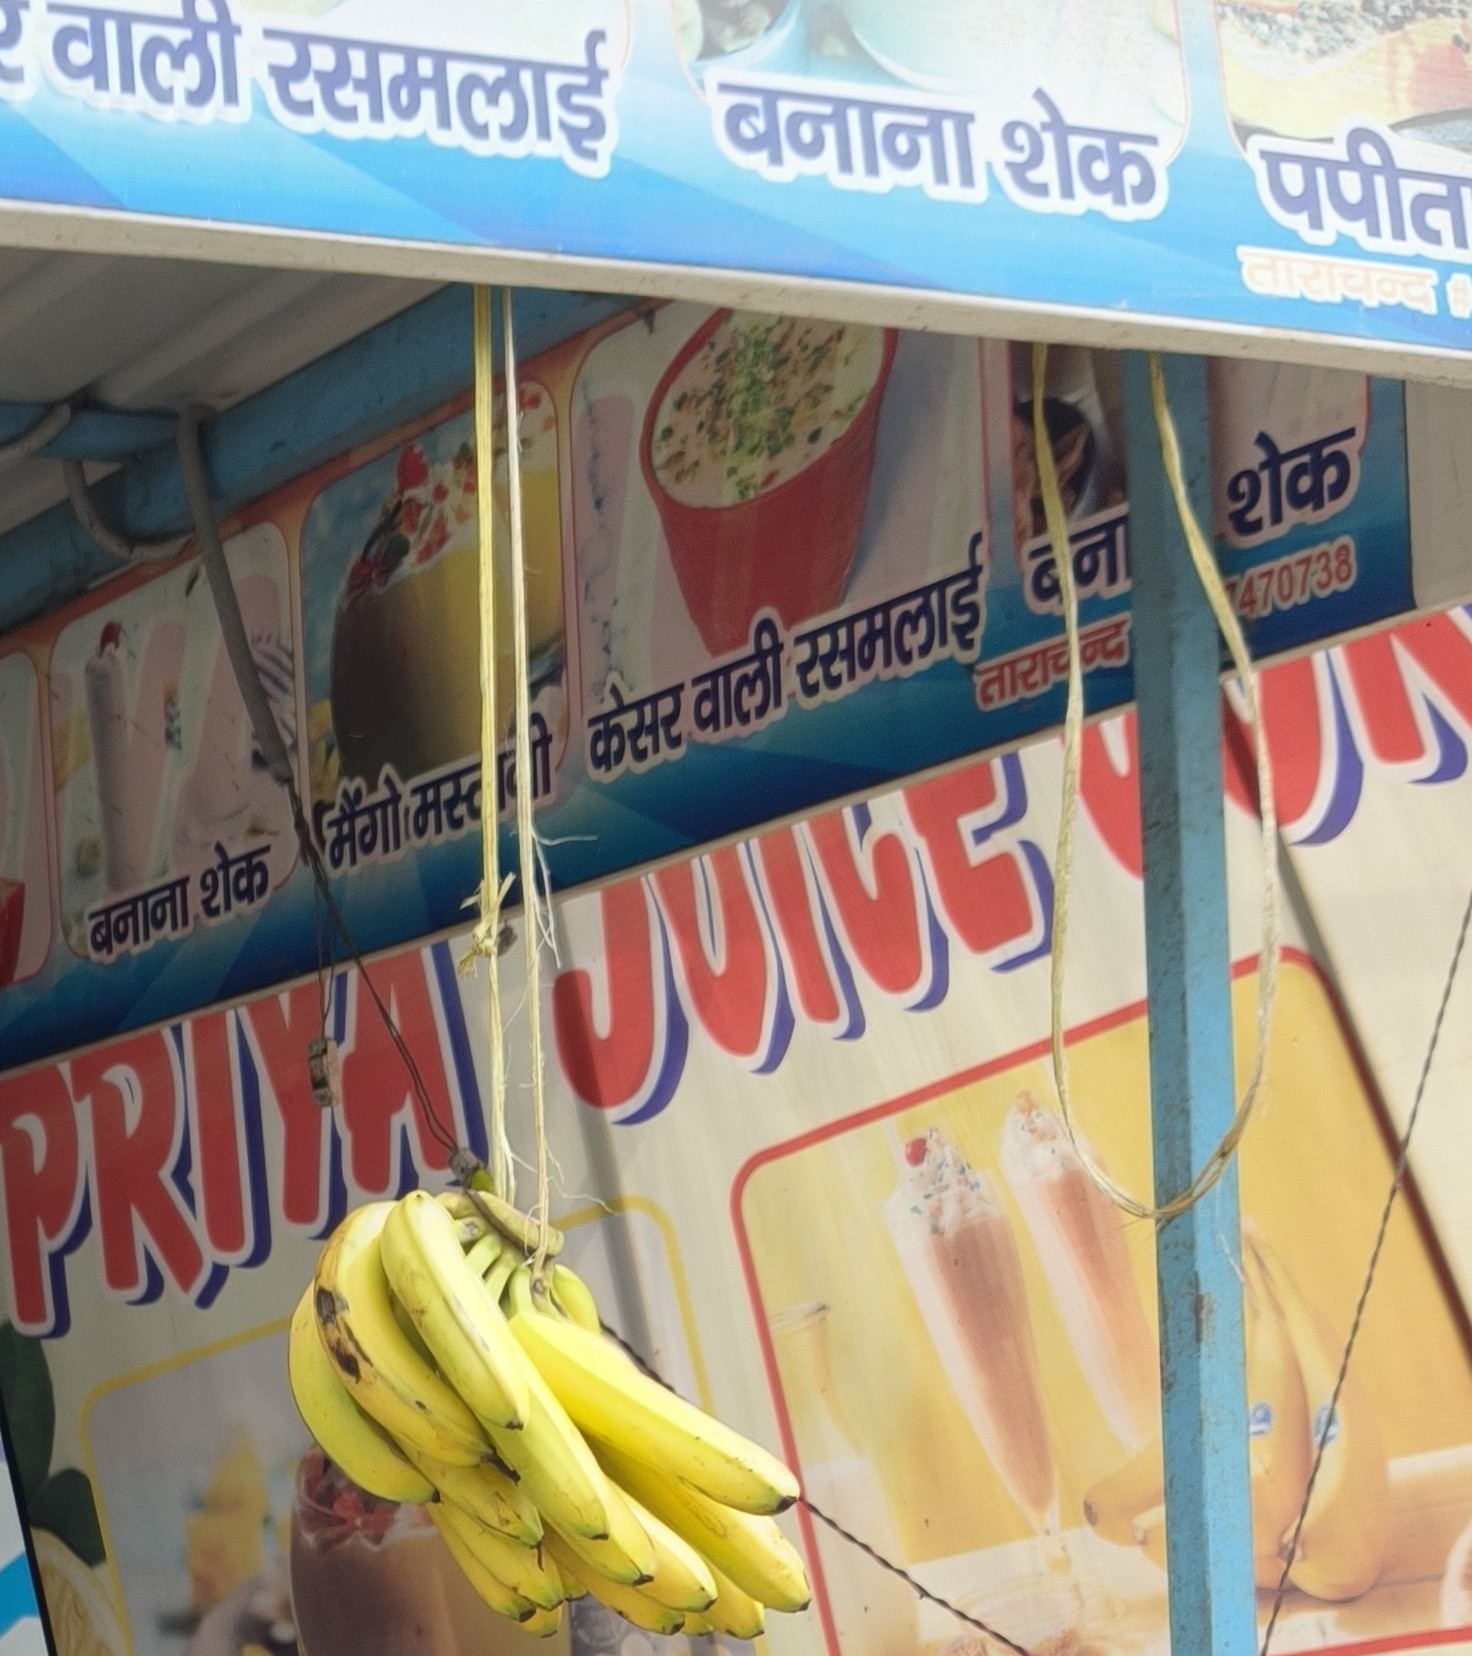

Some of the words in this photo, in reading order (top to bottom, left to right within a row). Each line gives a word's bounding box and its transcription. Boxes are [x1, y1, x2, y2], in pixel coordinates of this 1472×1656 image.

[262, 27, 609, 162] रसमलाई
[716, 81, 977, 190] बनाना
[1001, 87, 1158, 206] शेक
[1227, 430, 1356, 536] शेक
[587, 673, 686, 776] केसर
[691, 616, 784, 735] वाली
[794, 534, 984, 697] रसमलाई
[88, 875, 190, 957] बनाना
[199, 842, 271, 915] शेक
[553, 757, 1031, 1118] JUICE
